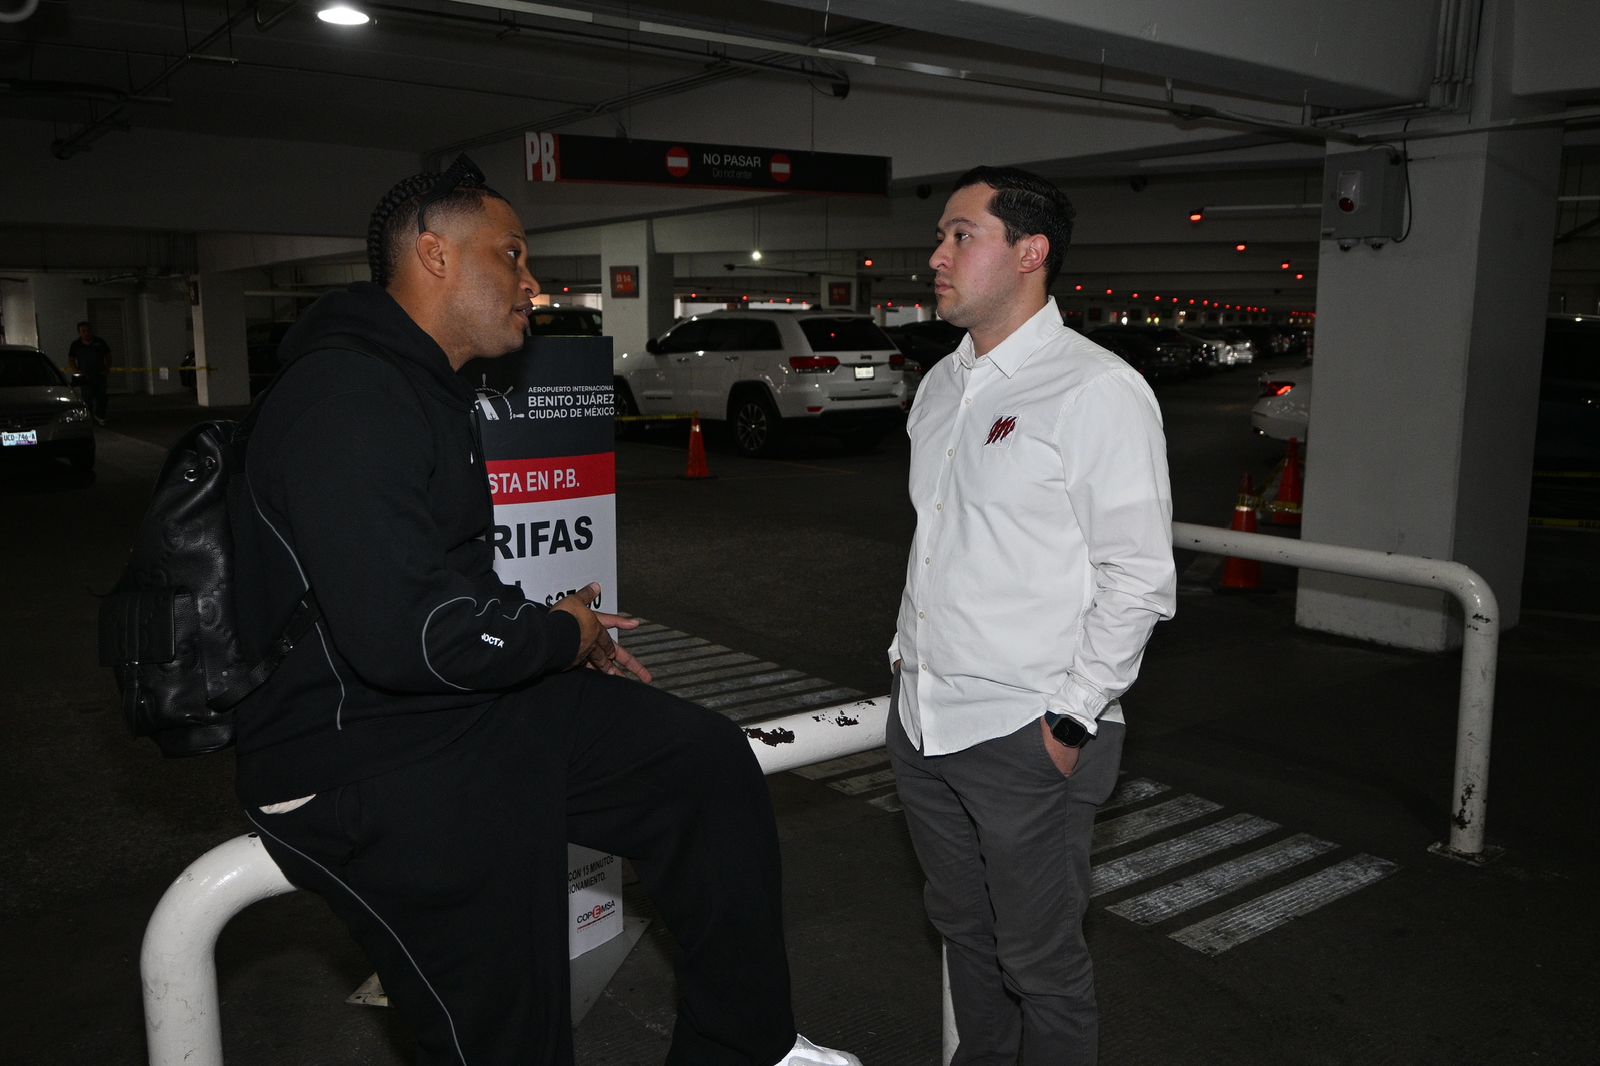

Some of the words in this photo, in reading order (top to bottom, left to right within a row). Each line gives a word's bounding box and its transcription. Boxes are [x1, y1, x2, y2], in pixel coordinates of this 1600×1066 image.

[525, 131, 556, 181] PB
[703, 152, 721, 166] NO
[723, 154, 761, 168] PASAR
[528, 395, 574, 407] BENITO
[576, 392, 615, 406] JUÁREZ
[528, 409, 568, 419] CIUDAD
[570, 408, 582, 418] DE
[584, 405, 615, 417] MÉXICO
[488, 472, 522, 494] STA
[527, 470, 549, 492] EN
[553, 468, 580, 489] P.B.
[492, 515, 594, 560] RIFAS
[568, 868, 581, 882] CON
[583, 866, 590, 877] 15
[589, 855, 614, 873] MINUTOS
[568, 872, 606, 895] IONAMIENTO.
